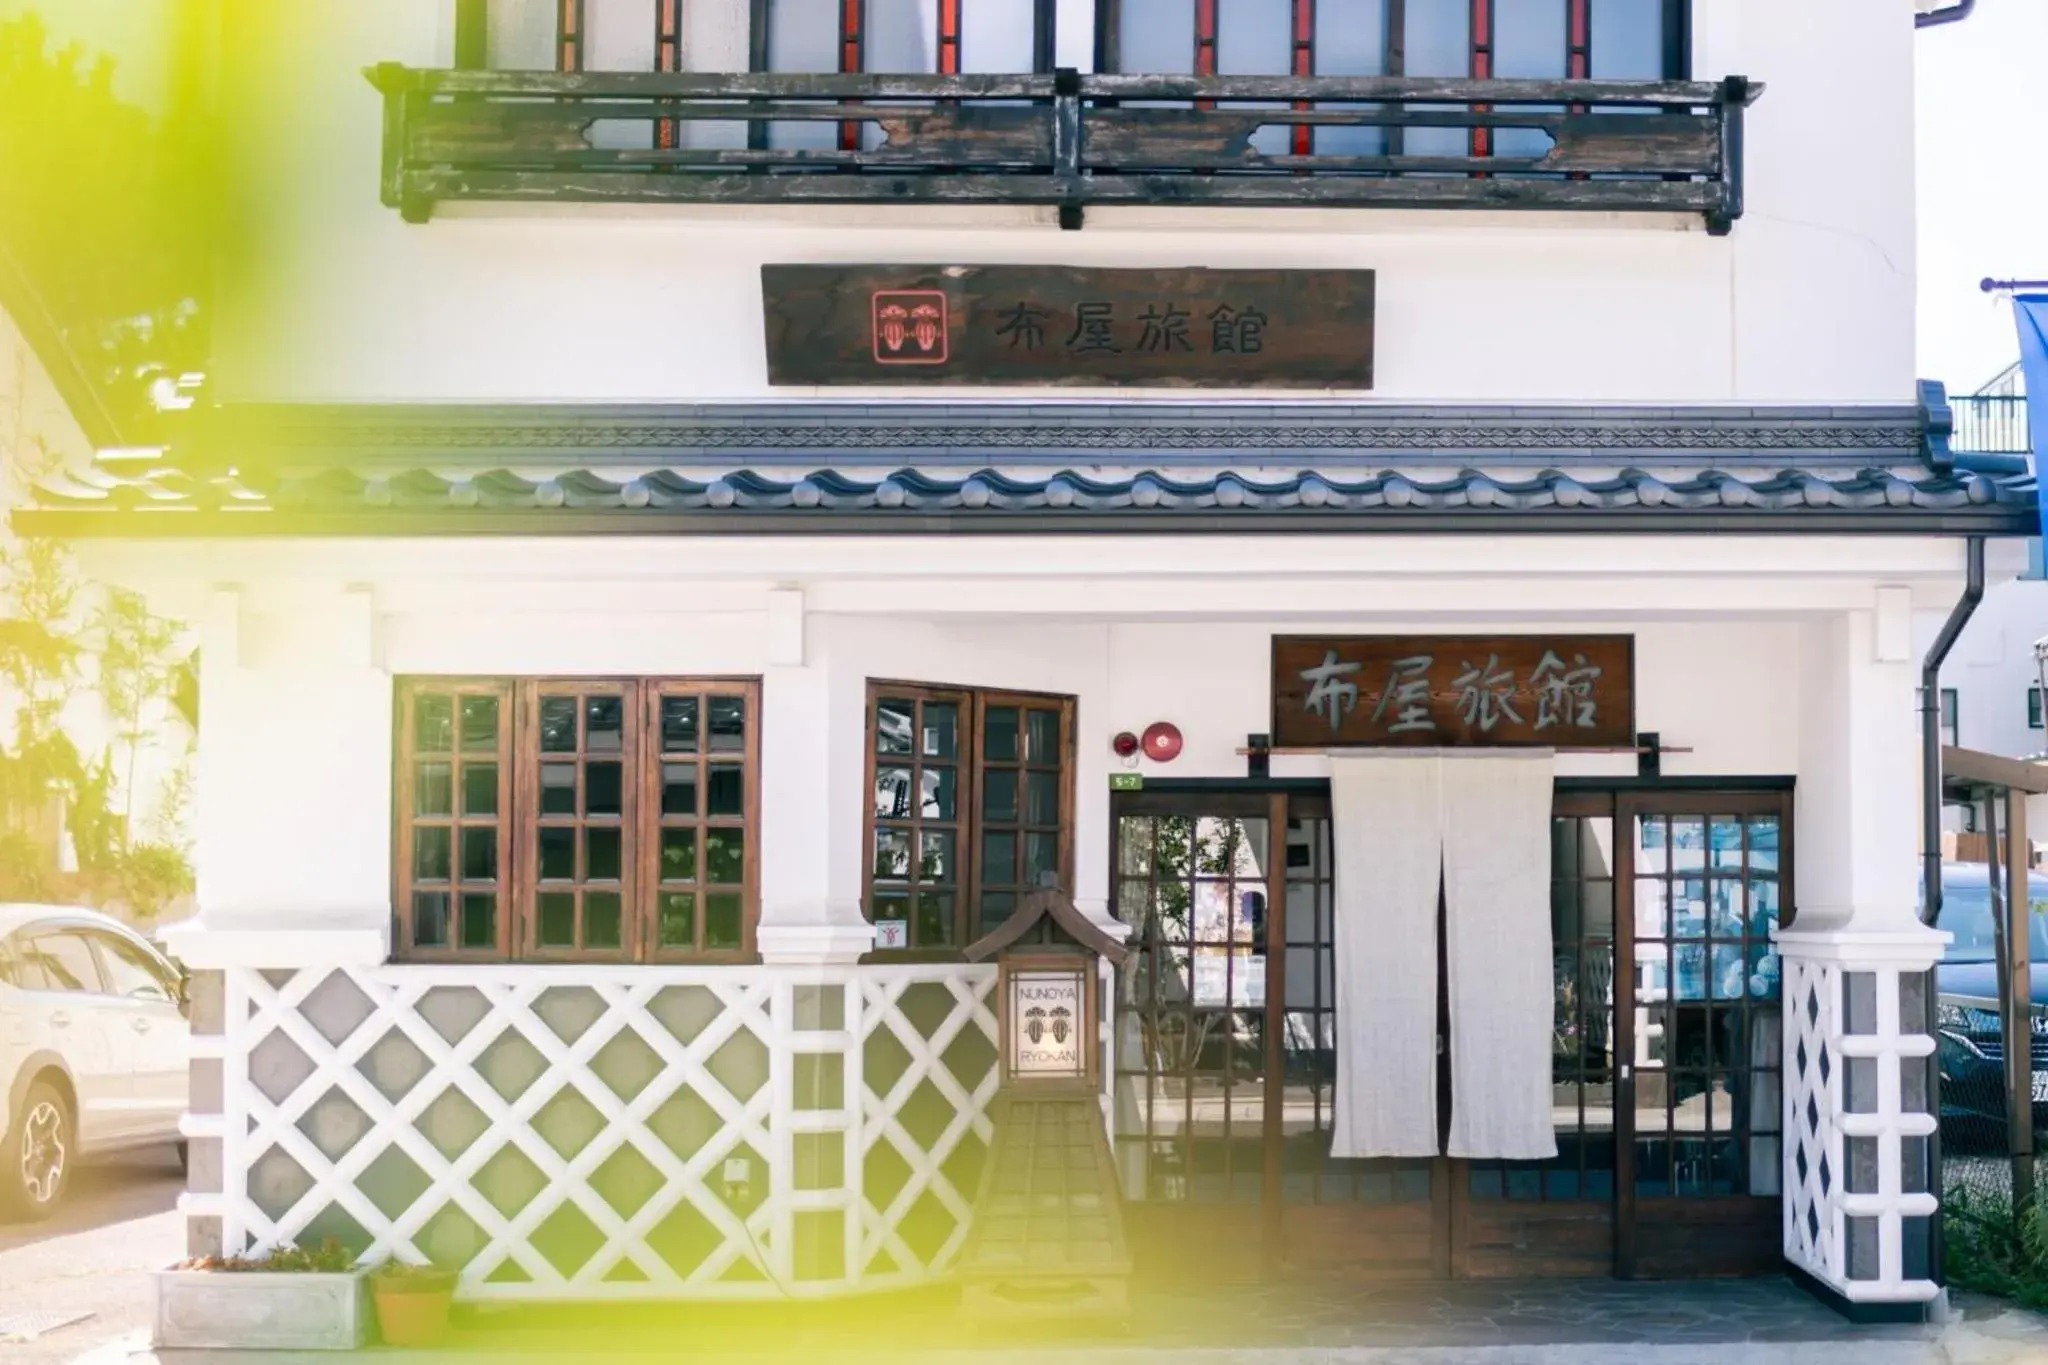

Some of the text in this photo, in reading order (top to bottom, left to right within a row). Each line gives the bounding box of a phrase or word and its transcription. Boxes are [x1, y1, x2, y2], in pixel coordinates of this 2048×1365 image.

[996, 301, 1267, 353] 布屋旅館
[1300, 650, 1601, 732] 布屋旅館
[1115, 777, 1136, 787] 5-7
[1020, 988, 1076, 1000] NUNOYA
